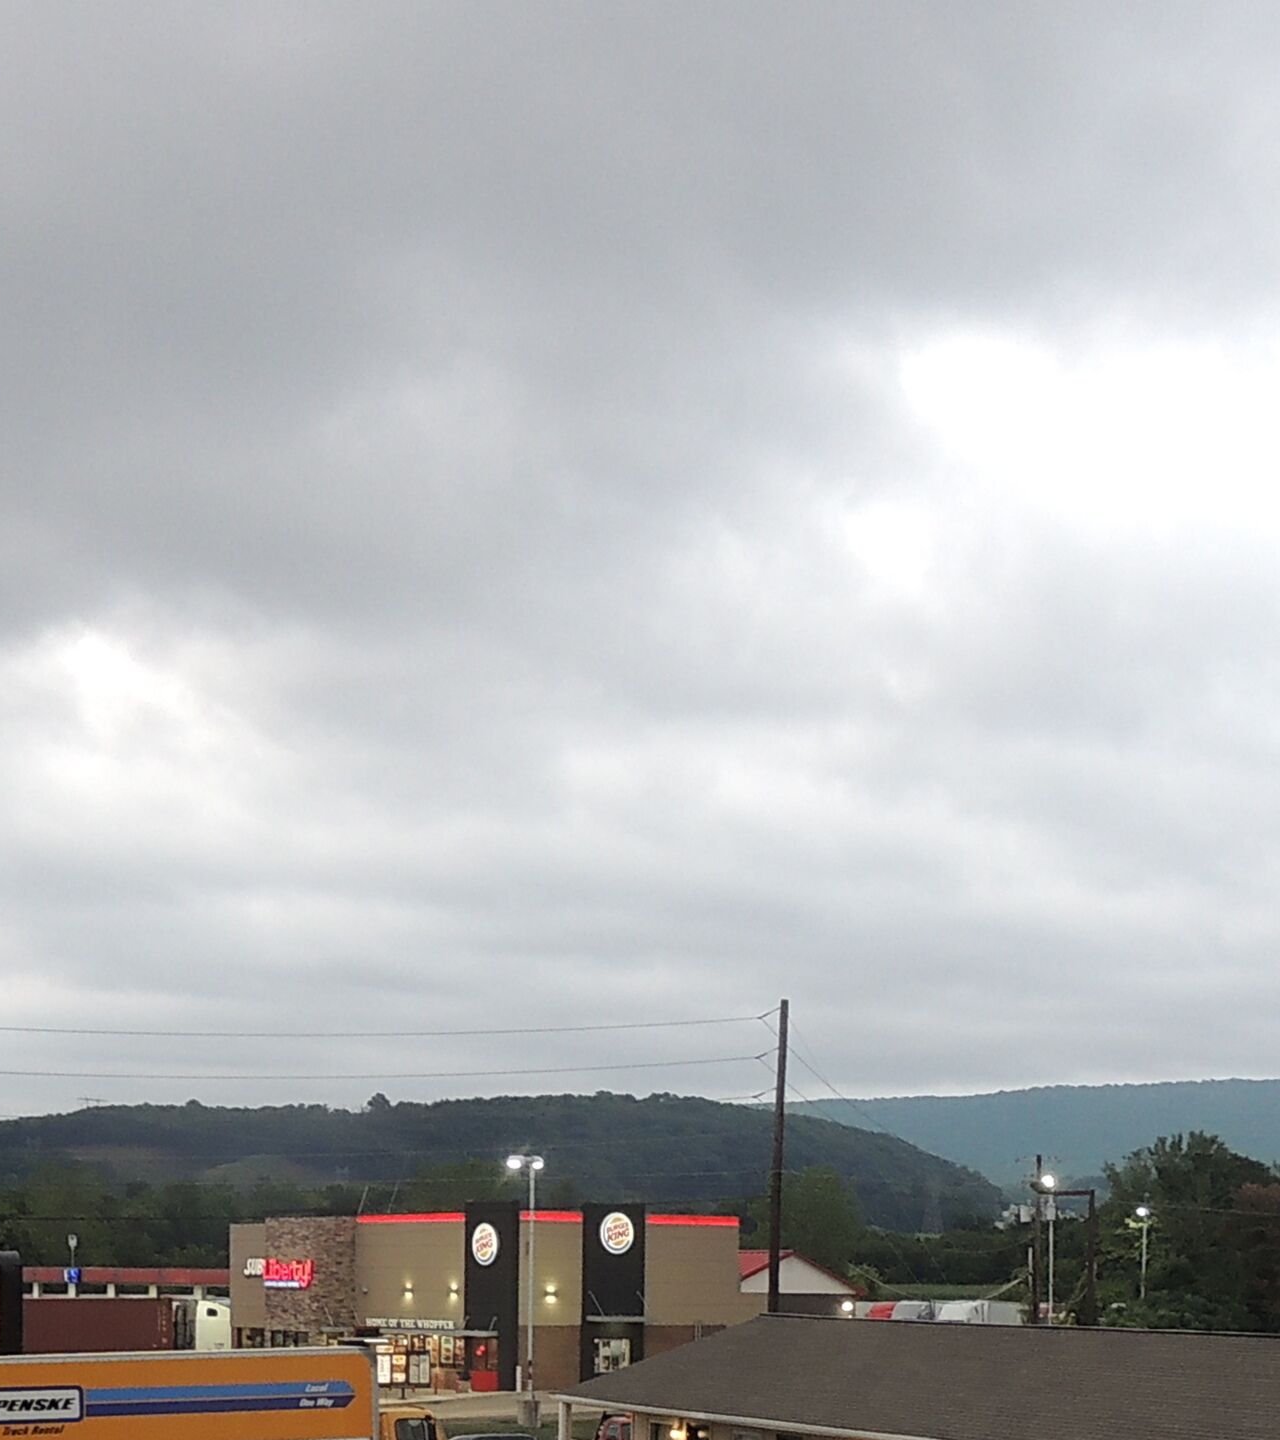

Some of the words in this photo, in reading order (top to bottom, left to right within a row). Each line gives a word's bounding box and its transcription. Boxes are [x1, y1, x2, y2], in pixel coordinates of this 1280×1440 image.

[606, 1222, 629, 1233] BURGER
[607, 1228, 630, 1242] KING
[476, 1240, 493, 1252] KING
[263, 1258, 312, 1288] Liberty!
[365, 1318, 388, 1327] HOME
[389, 1319, 398, 1327] OF
[399, 1319, 416, 1328] THE
[416, 1319, 455, 1329] WHOPPER
[305, 1383, 329, 1393] Local
[299, 1398, 315, 1407] One
[316, 1398, 335, 1407] Way
[2, 1426, 29, 1436] Truck
[31, 1425, 65, 1436] Rental
